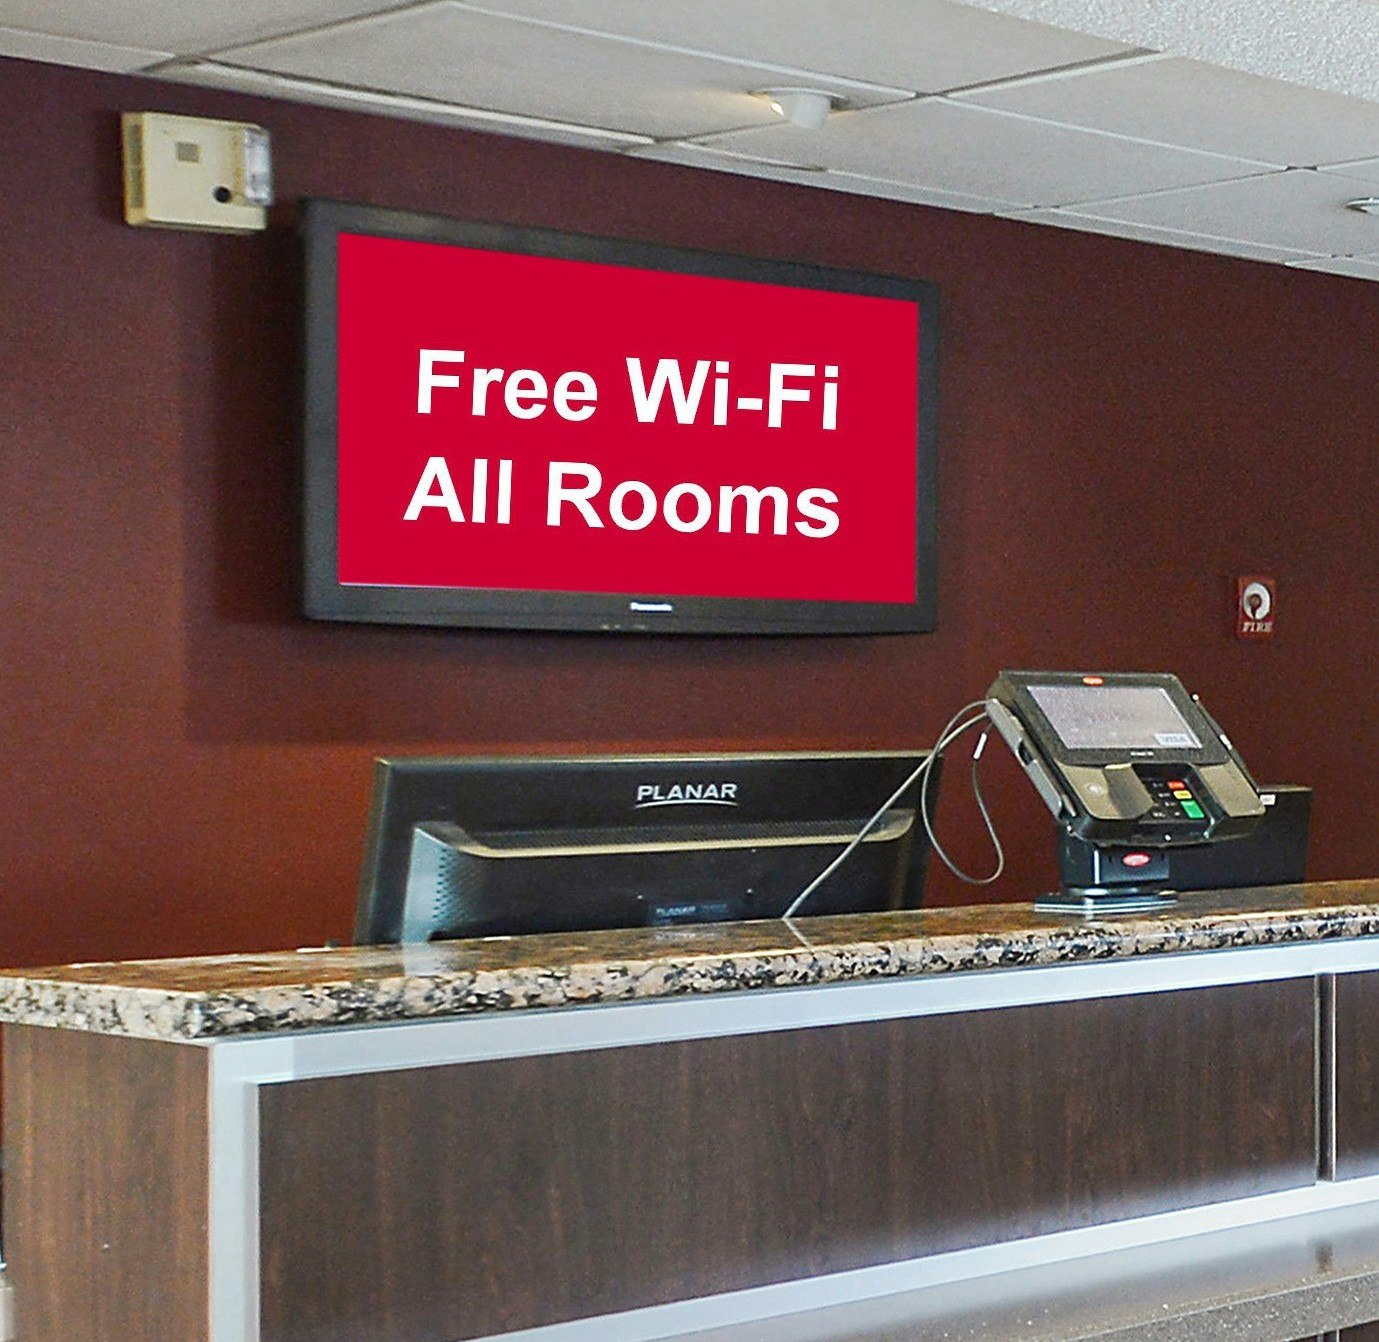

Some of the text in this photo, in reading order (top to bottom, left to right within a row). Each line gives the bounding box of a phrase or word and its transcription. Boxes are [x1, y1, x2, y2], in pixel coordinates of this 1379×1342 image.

[418, 348, 839, 431] Free Wi-Fi
[402, 456, 840, 539] All Rooms
[1242, 621, 1273, 633] FIRE
[636, 783, 738, 801] PLANAR
